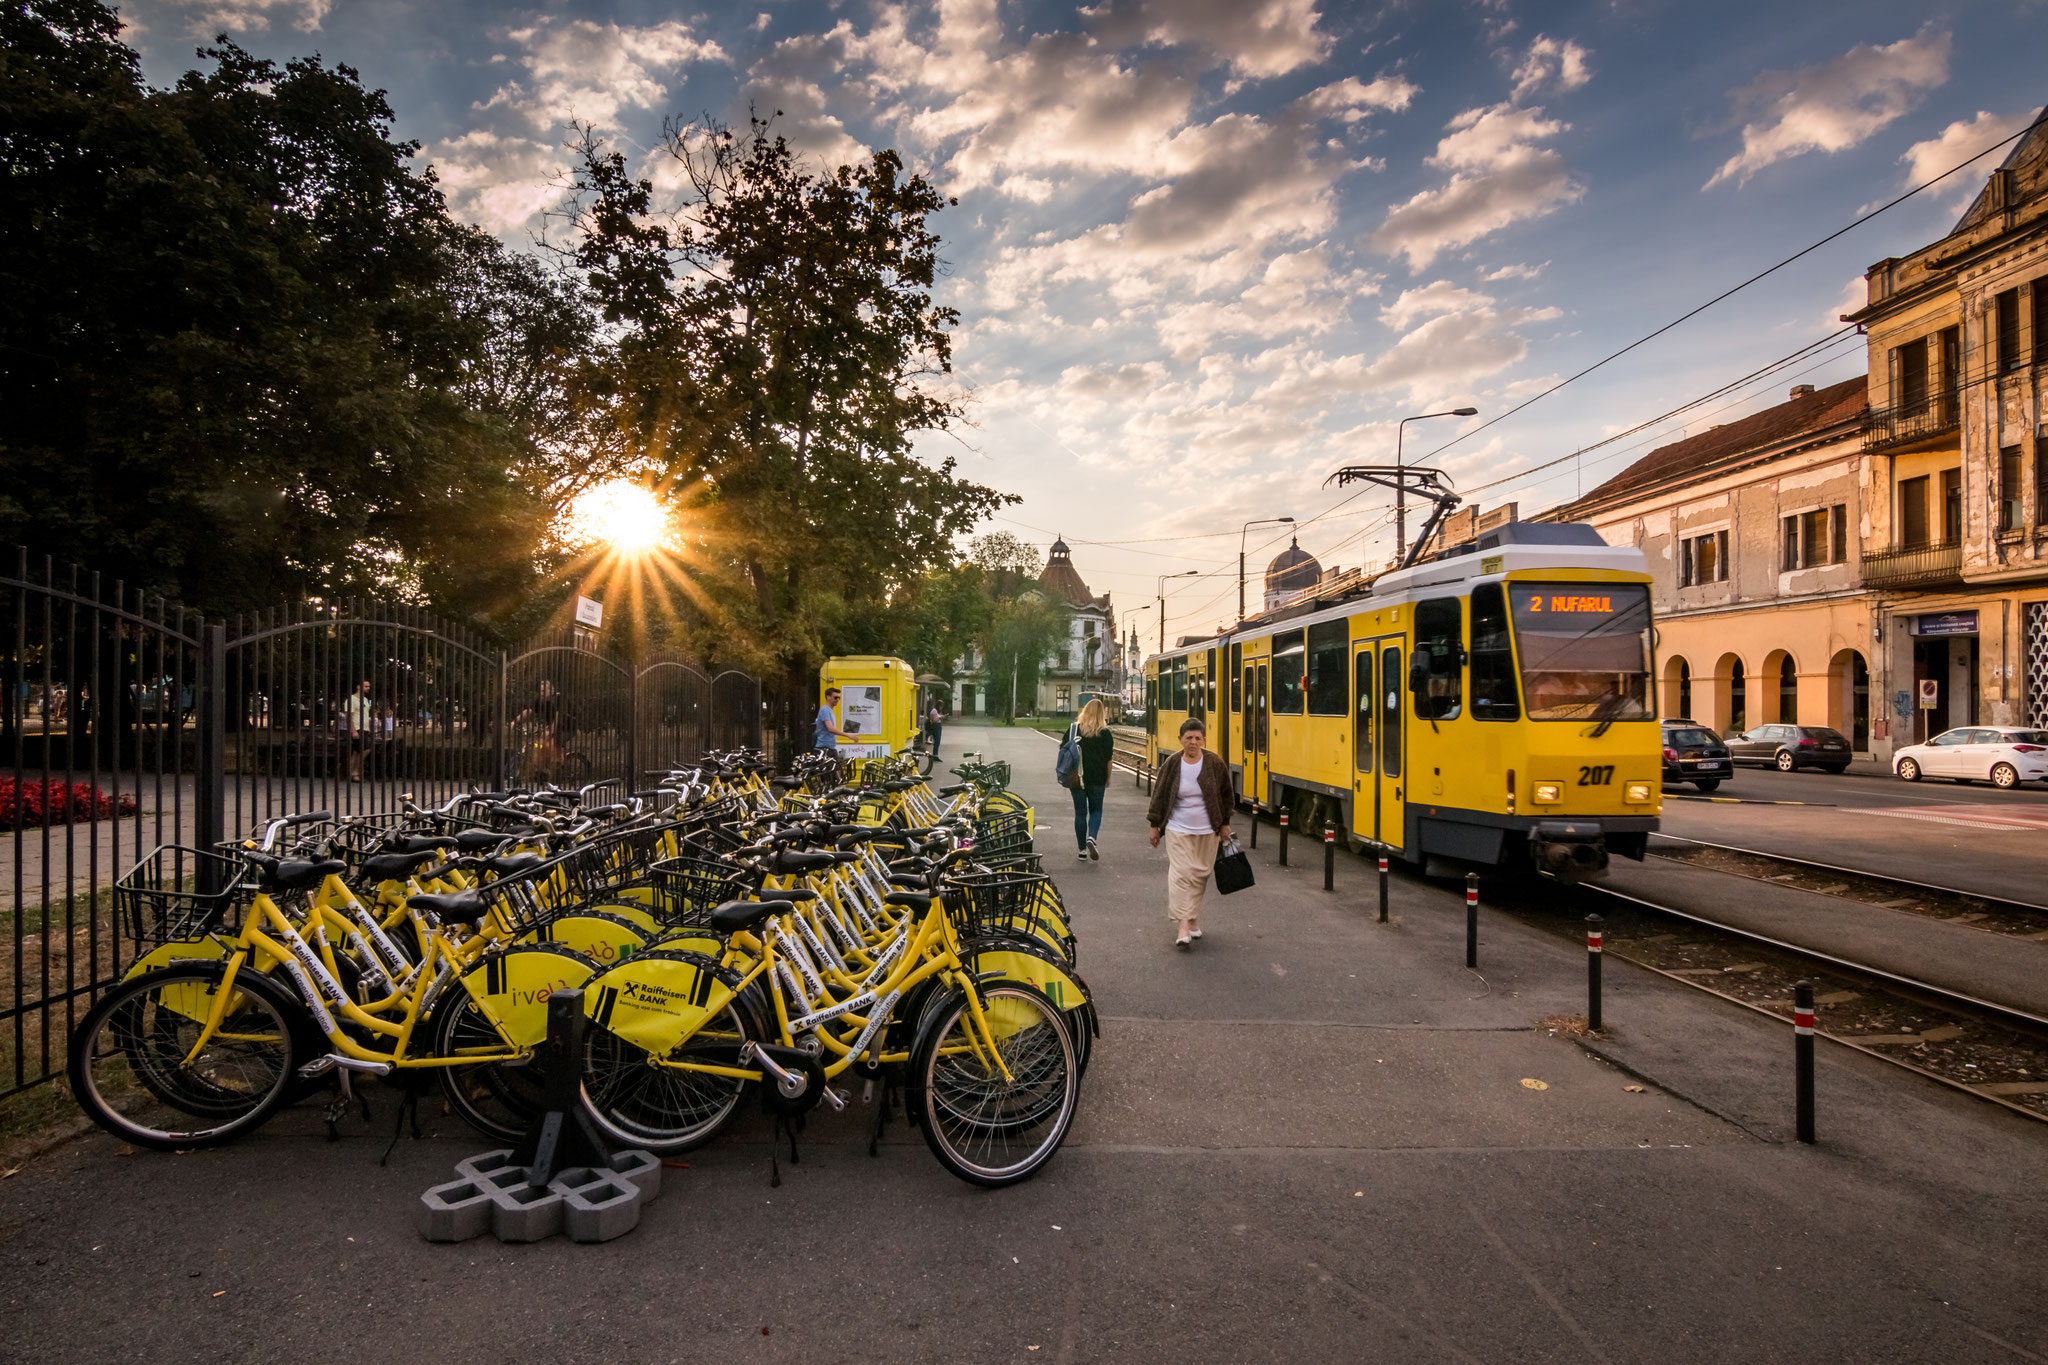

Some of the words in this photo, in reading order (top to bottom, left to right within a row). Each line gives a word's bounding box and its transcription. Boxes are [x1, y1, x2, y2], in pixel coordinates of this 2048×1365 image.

[1530, 596, 1543, 612] 2
[1551, 596, 1614, 612] NUFARUL
[1578, 765, 1615, 786] 207
[819, 901, 839, 931] Raiffeisen
[839, 930, 853, 948] BANK
[840, 887, 860, 914] Raiffeisen
[859, 912, 872, 929] BANK
[359, 915, 384, 947] Raiffeisen
[384, 947, 402, 967] BANK
[777, 936, 802, 970] Raiffeisen
[802, 970, 820, 991] BANK
[795, 915, 817, 947] Raiffeisen
[816, 947, 832, 967] BANK
[869, 951, 898, 983] Raiffeisen
[896, 937, 908, 952] BA
[294, 945, 324, 981] Raiffeisen
[323, 980, 344, 1002] BANK
[641, 983, 687, 1000] Raiffeisen
[294, 972, 331, 1033] GreenRevolution
[619, 1000, 640, 1010] Banking
[638, 994, 668, 1007] BANK
[805, 1006, 846, 1028] Raiffeisen
[848, 996, 872, 1011] BANK
[856, 992, 899, 1050] GreenRevolution
